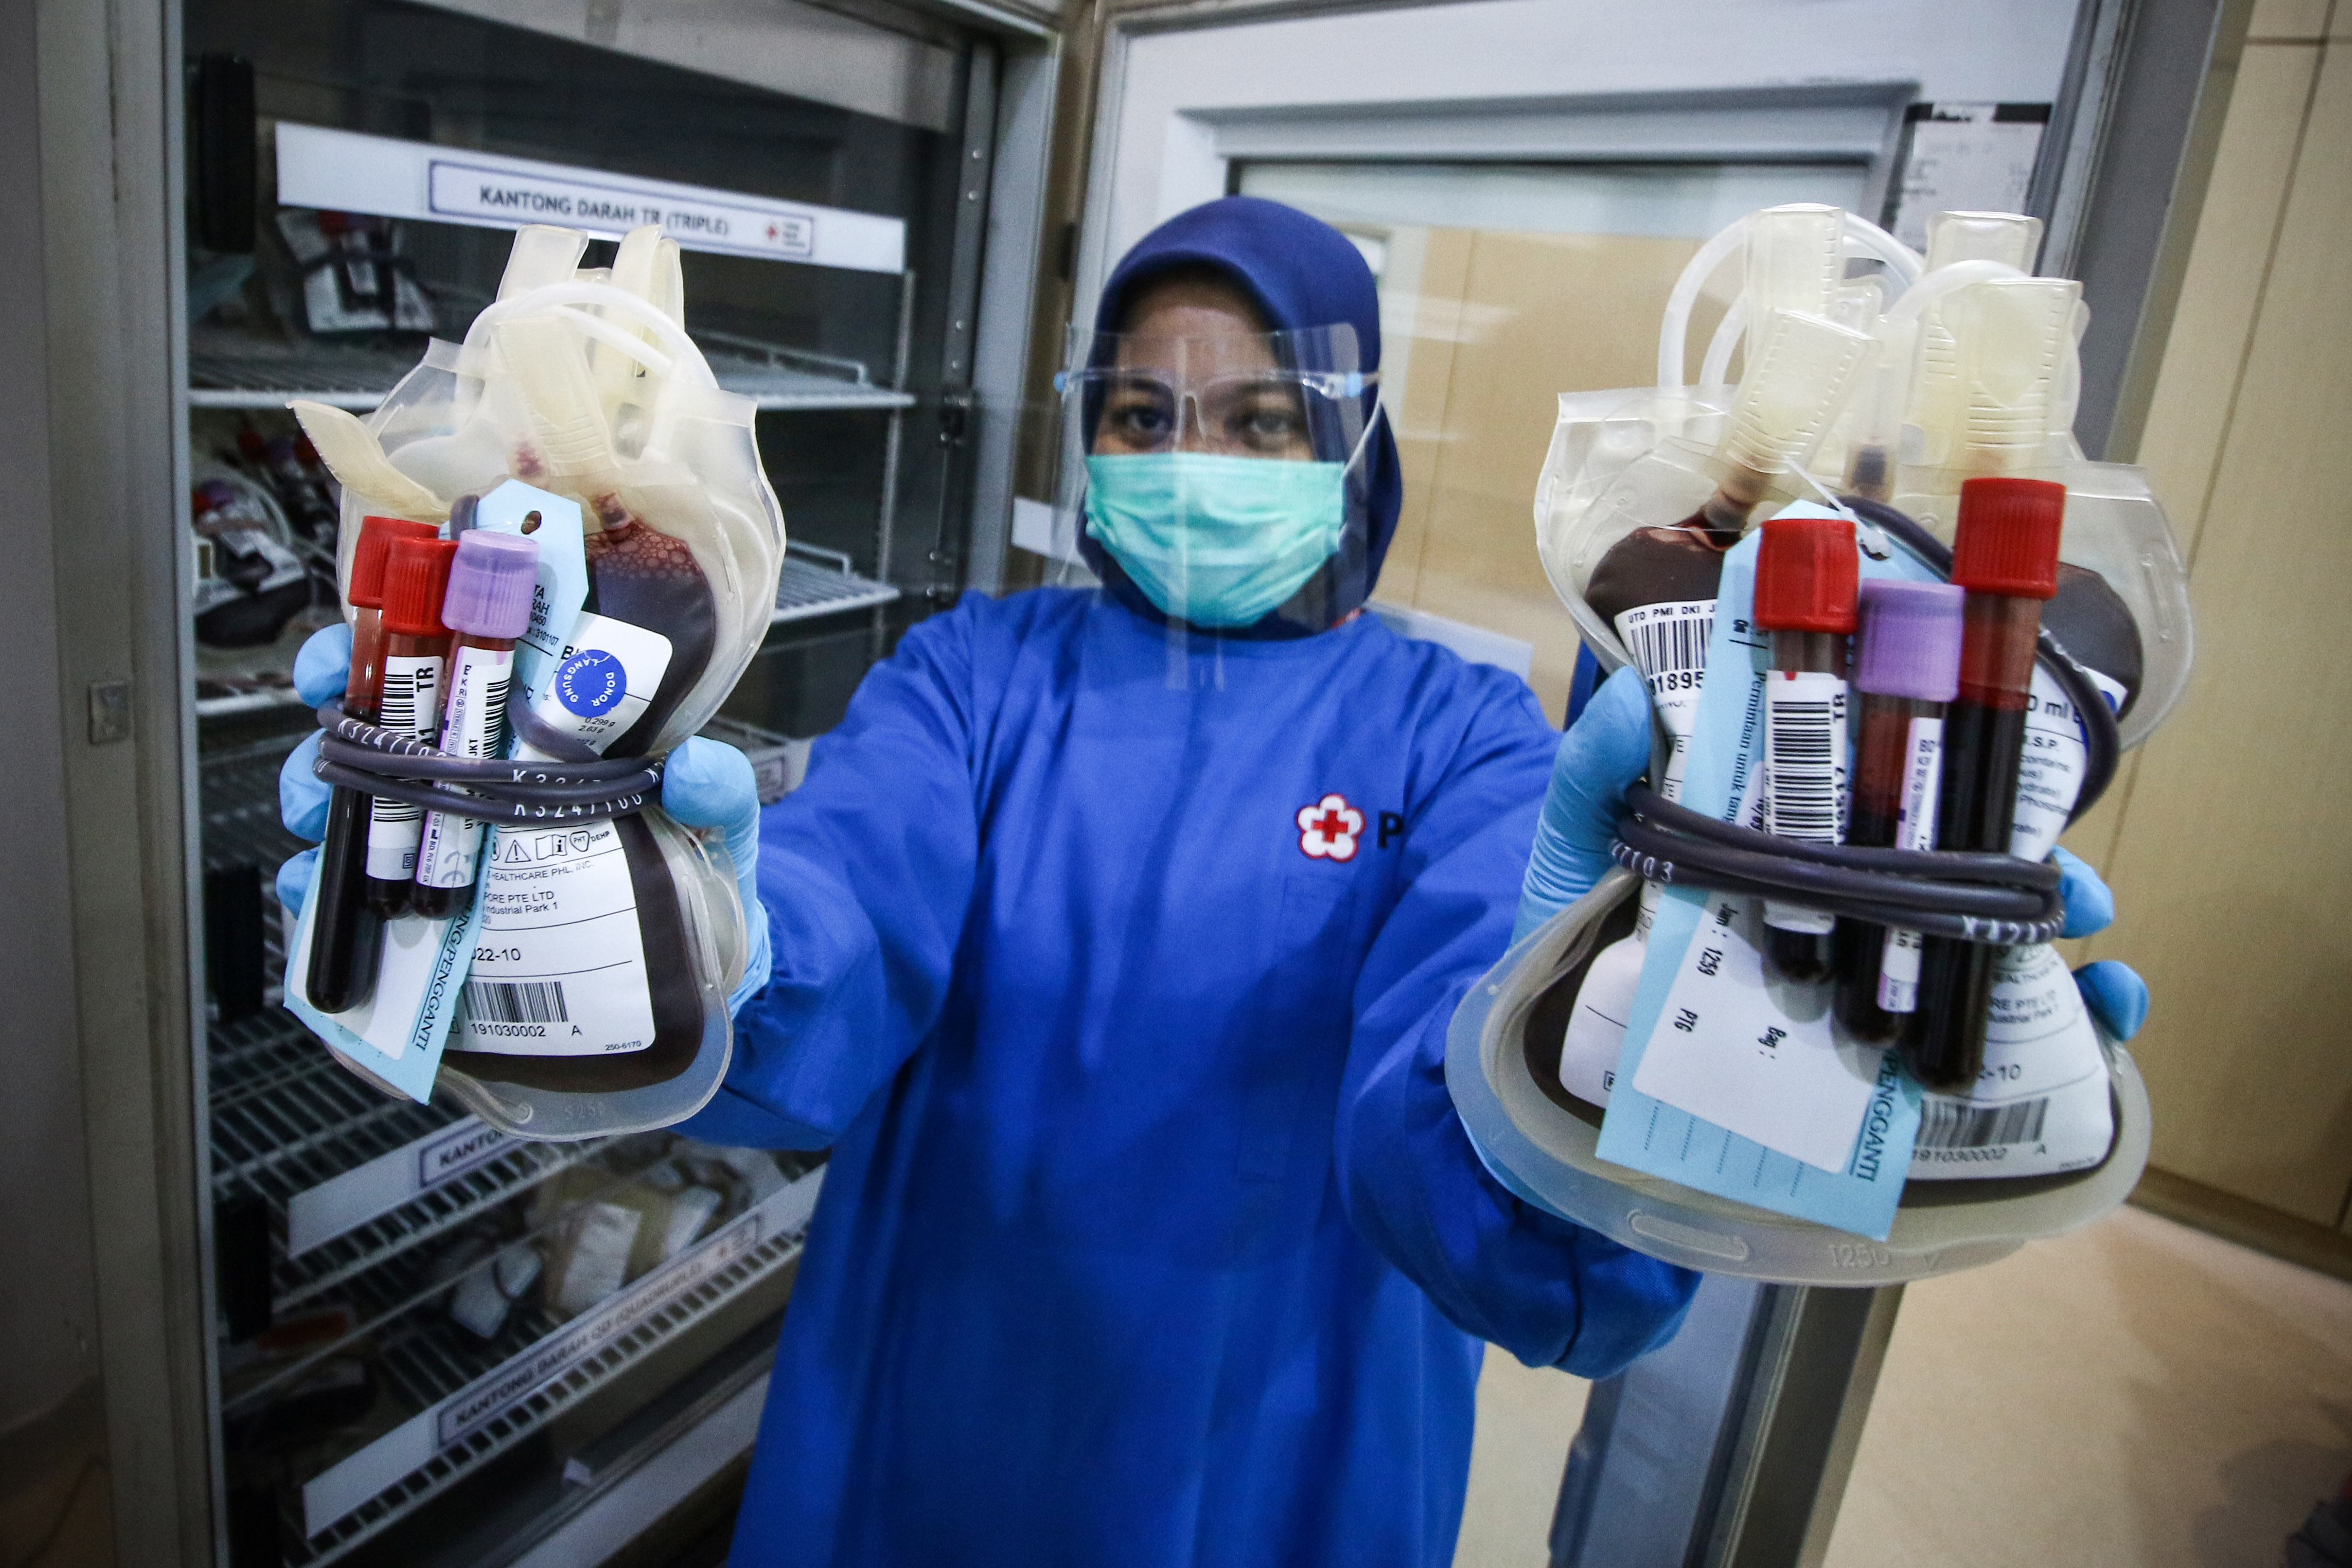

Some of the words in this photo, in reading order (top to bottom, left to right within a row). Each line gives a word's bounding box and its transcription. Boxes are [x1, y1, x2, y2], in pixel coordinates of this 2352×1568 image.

[480, 185, 572, 215] KANTONG
[578, 199, 636, 222] DARAH
[666, 212, 730, 237] (TRIPLE)
[1653, 607, 1674, 618] PMI
[1682, 605, 1701, 615] DKI
[416, 667, 434, 693] TR
[562, 658, 599, 703] LANGSUNG
[590, 671, 616, 707] DONOR
[2045, 701, 2070, 719] ml
[585, 717, 608, 726] 0.299
[468, 738, 478, 756] JKT
[1731, 752, 1747, 792] untuk
[591, 830, 610, 843] DEHP
[551, 867, 573, 876] PHL,
[576, 860, 594, 871] INC.
[508, 894, 529, 903] PTE
[532, 890, 554, 902] LTD
[525, 903, 549, 914] Park
[552, 901, 558, 910] 1
[471, 1023, 546, 1037] 191030002
[571, 1024, 582, 1035] A
[1673, 1007, 1699, 1033] PTG
[1757, 1025, 1788, 1049] Bag
[605, 1040, 642, 1051] 250-6170
[439, 1128, 502, 1167] KANTO
[455, 1367, 535, 1425] KANTONG
